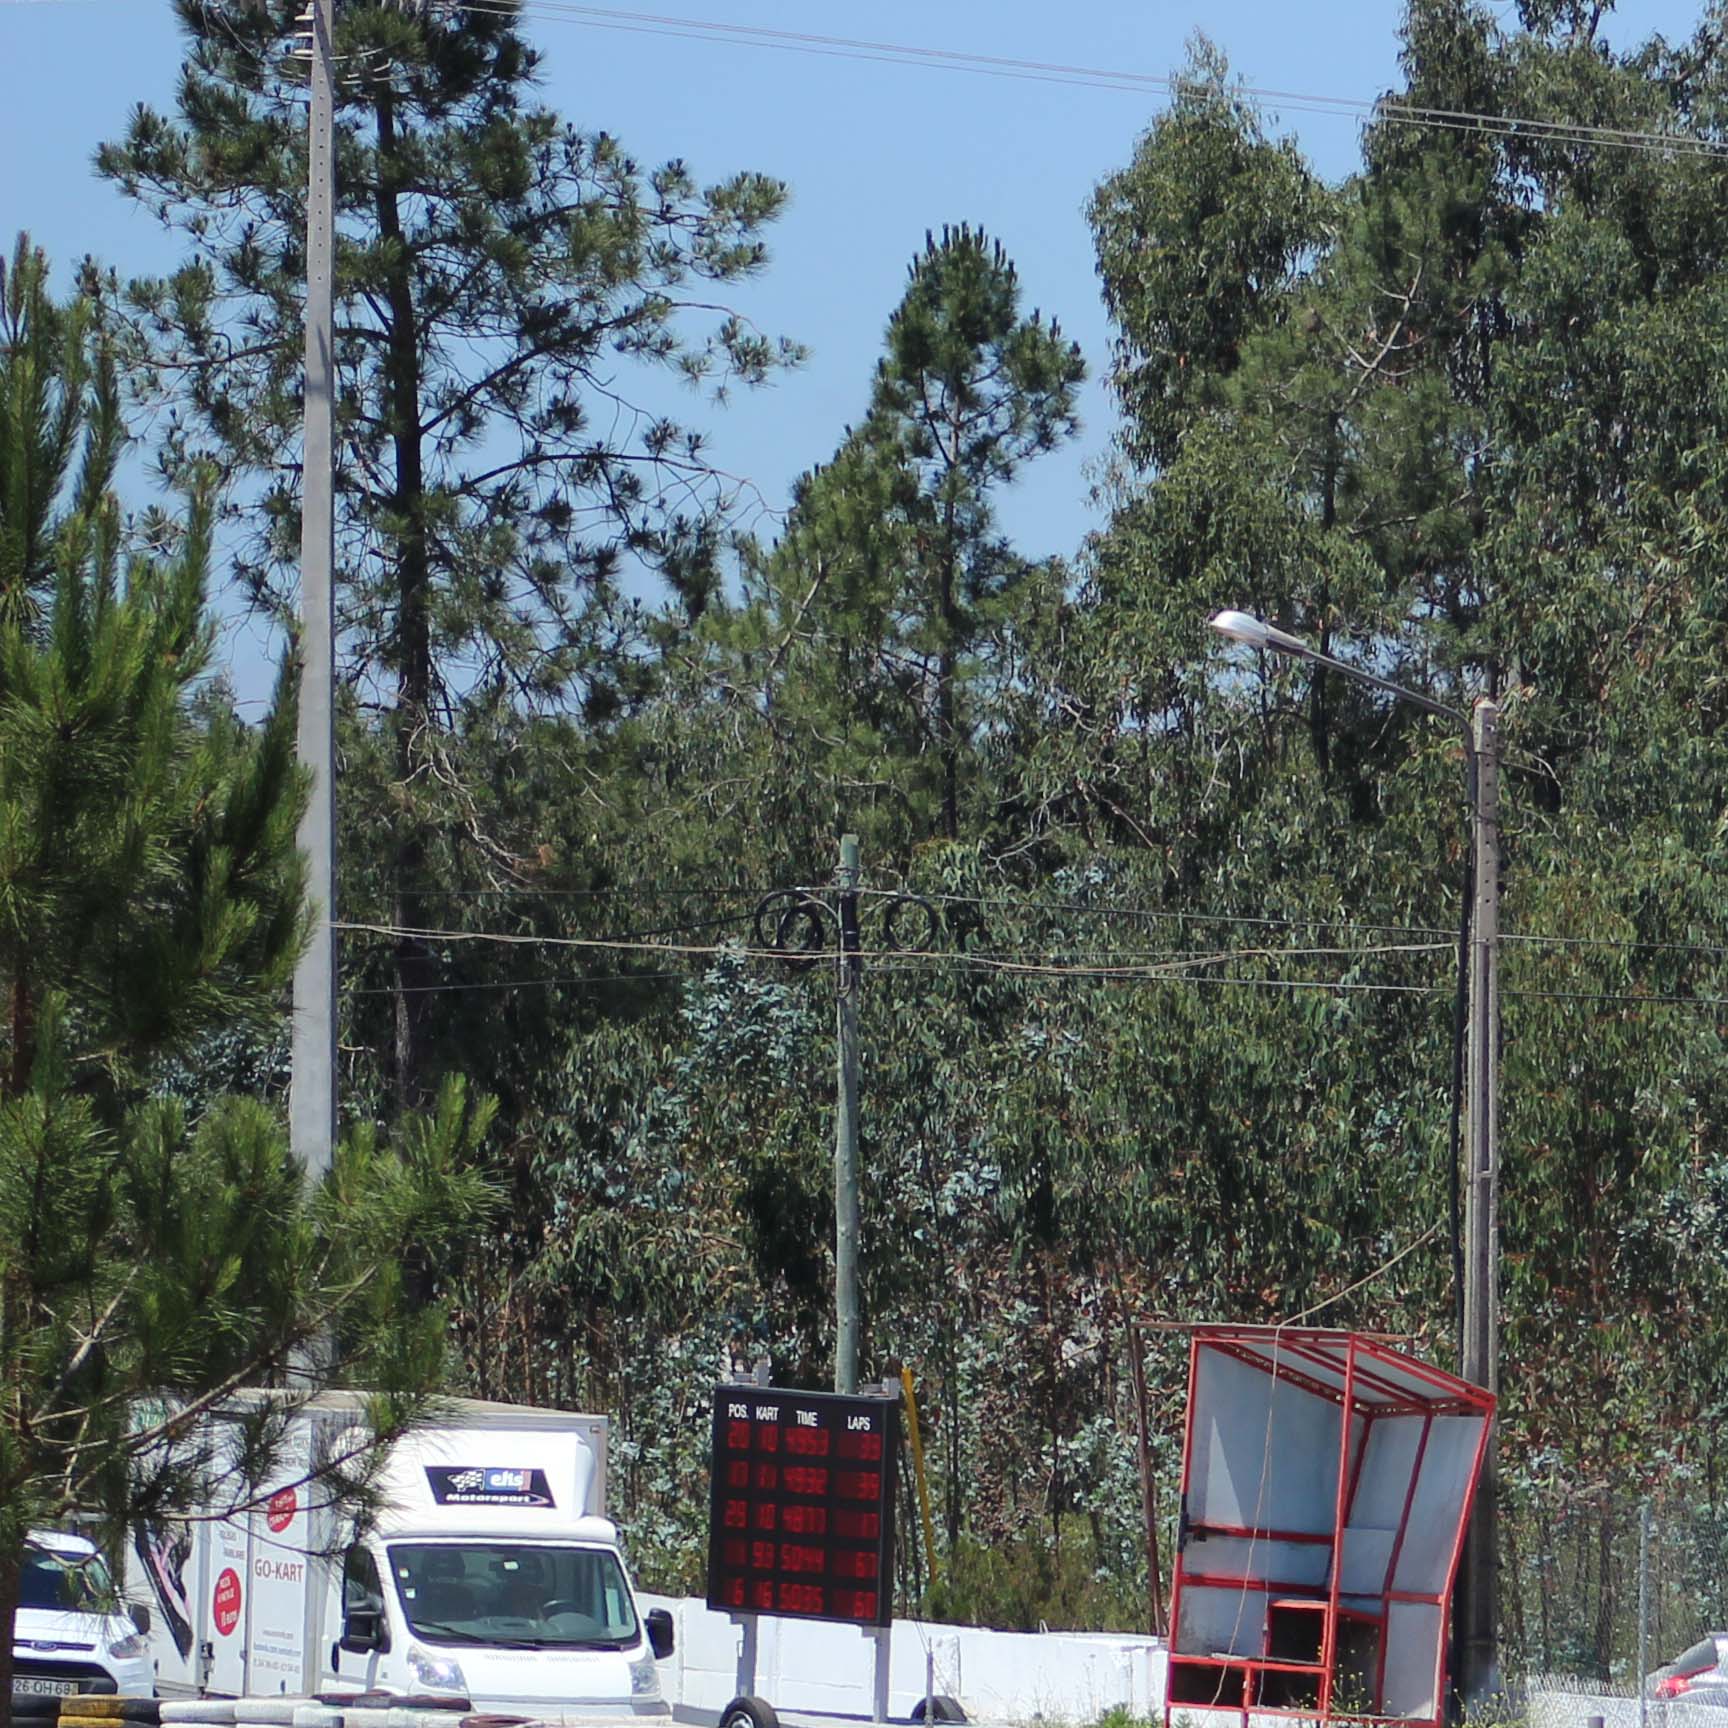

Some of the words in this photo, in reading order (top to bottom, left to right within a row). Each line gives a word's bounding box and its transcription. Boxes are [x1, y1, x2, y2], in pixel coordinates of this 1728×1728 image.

[728, 1404, 749, 1418] POS.
[756, 1406, 779, 1421] KART
[796, 1410, 818, 1427] TIME
[848, 1416, 870, 1431] LAPS
[446, 1493, 531, 1504] Motorsport
[255, 1558, 303, 1583] GO-KART
